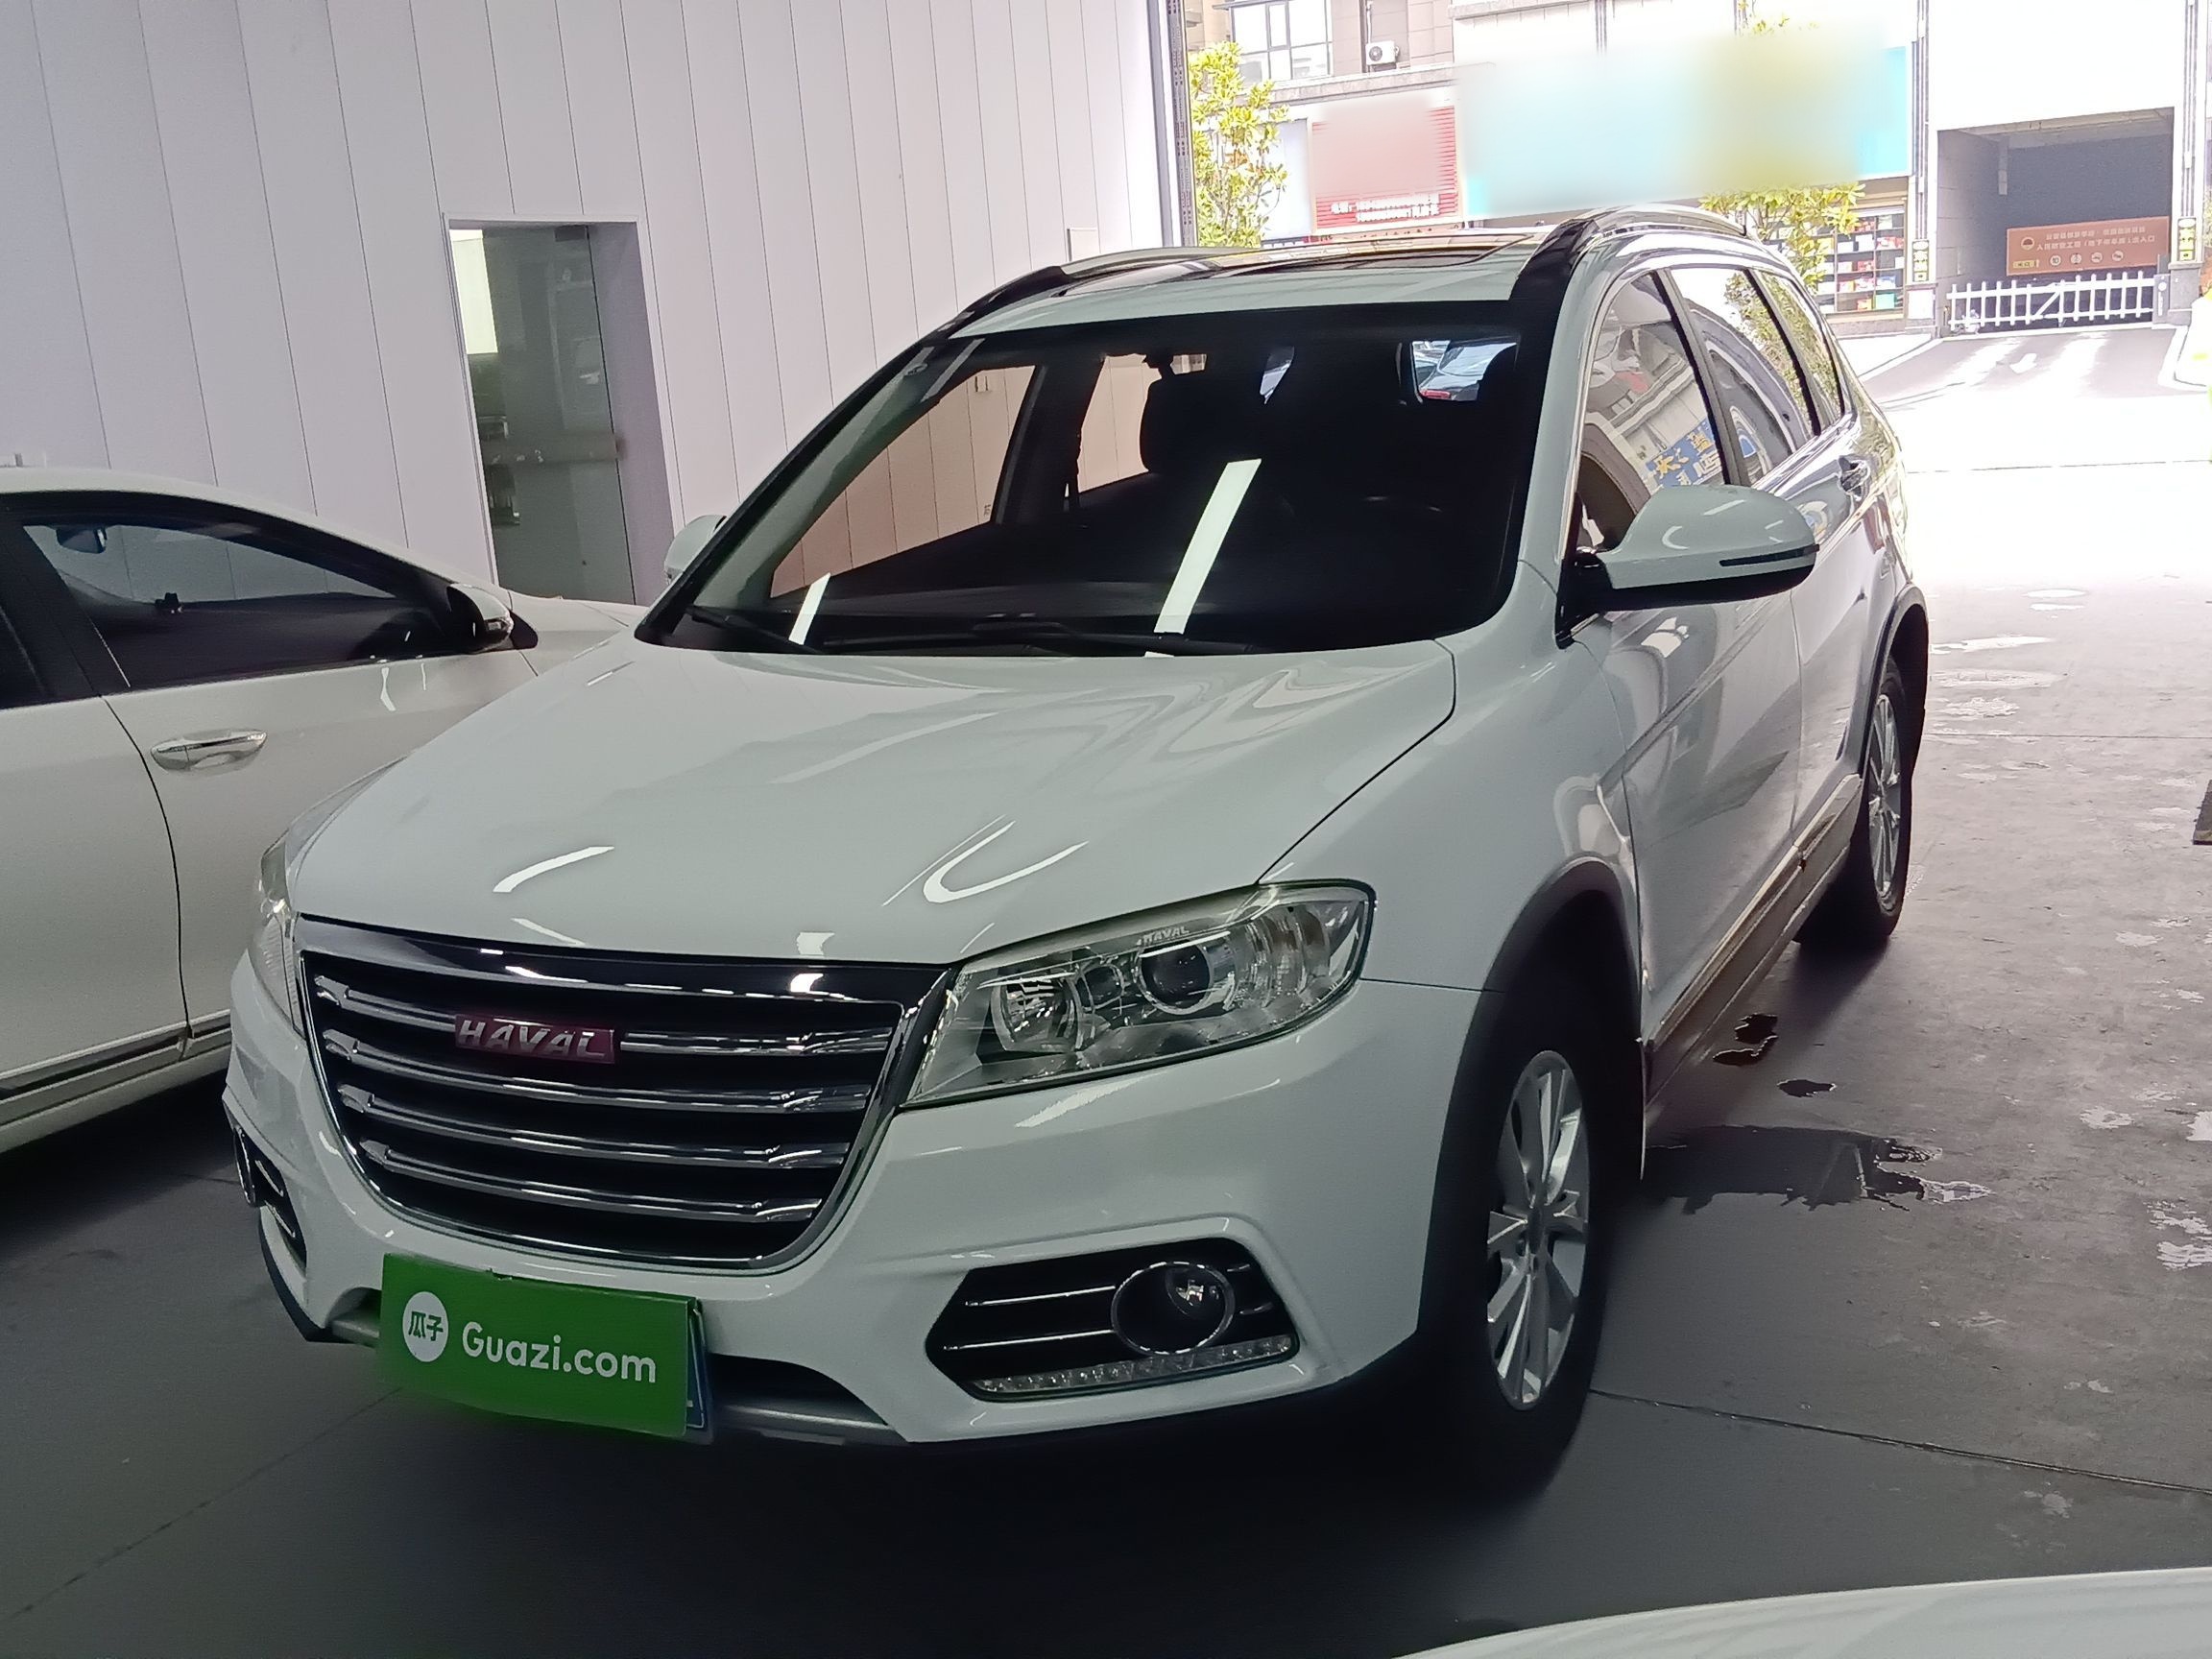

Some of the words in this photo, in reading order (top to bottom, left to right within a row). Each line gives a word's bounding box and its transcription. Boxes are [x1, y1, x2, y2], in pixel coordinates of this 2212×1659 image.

[1143, 926, 1190, 944] HAVAL
[459, 1020, 606, 1058] HAVAL
[408, 1310, 444, 1341] 瓜子
[462, 1321, 657, 1384] Guazi.com
